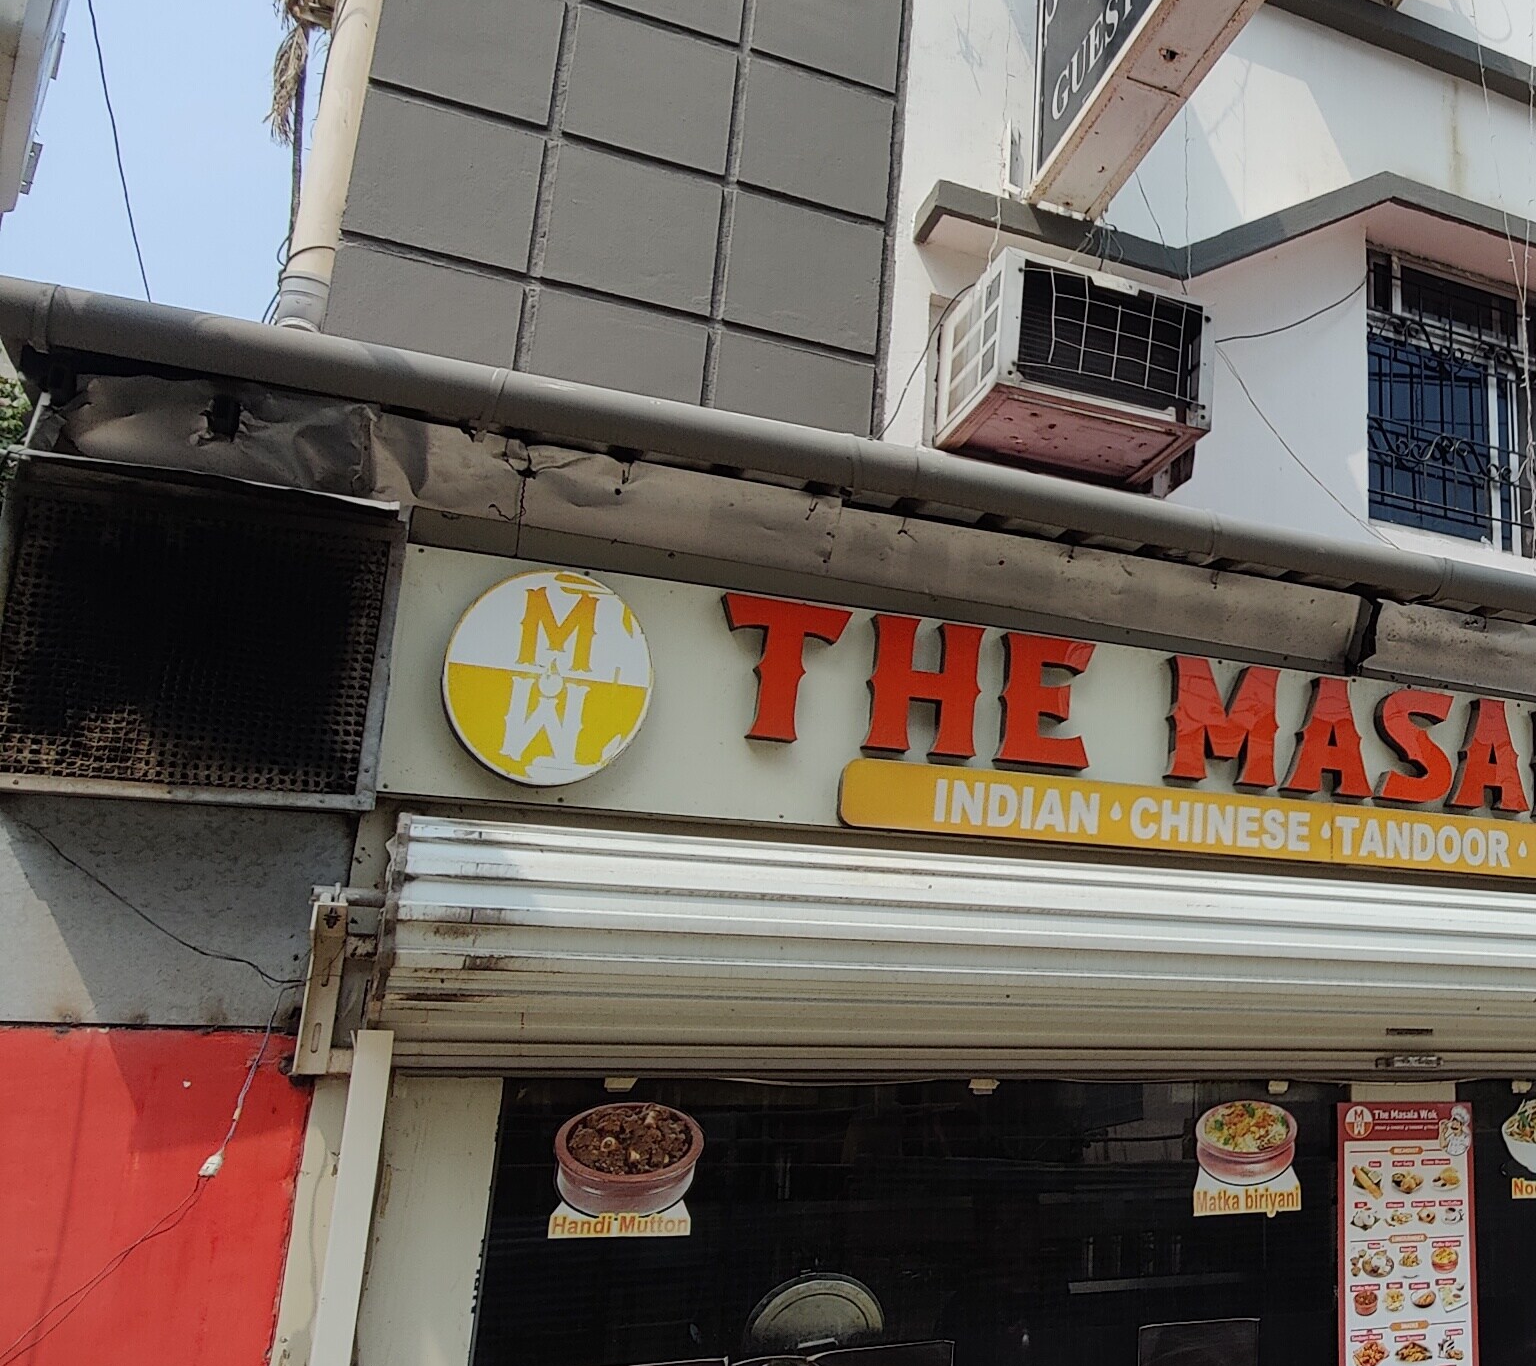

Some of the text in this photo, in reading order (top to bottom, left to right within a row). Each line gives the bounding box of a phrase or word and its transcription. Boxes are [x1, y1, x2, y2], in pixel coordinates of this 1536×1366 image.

[722, 592, 1096, 771] THE
[934, 778, 1100, 835] INDIAN
[1130, 797, 1311, 852] CHINESE
[1332, 816, 1510, 868] TANDOOR
[1373, 1108, 1438, 1119] The Masala Wok
[1194, 1183, 1302, 1218] Matka biriyani
[549, 1213, 690, 1237] Handi Mutton
